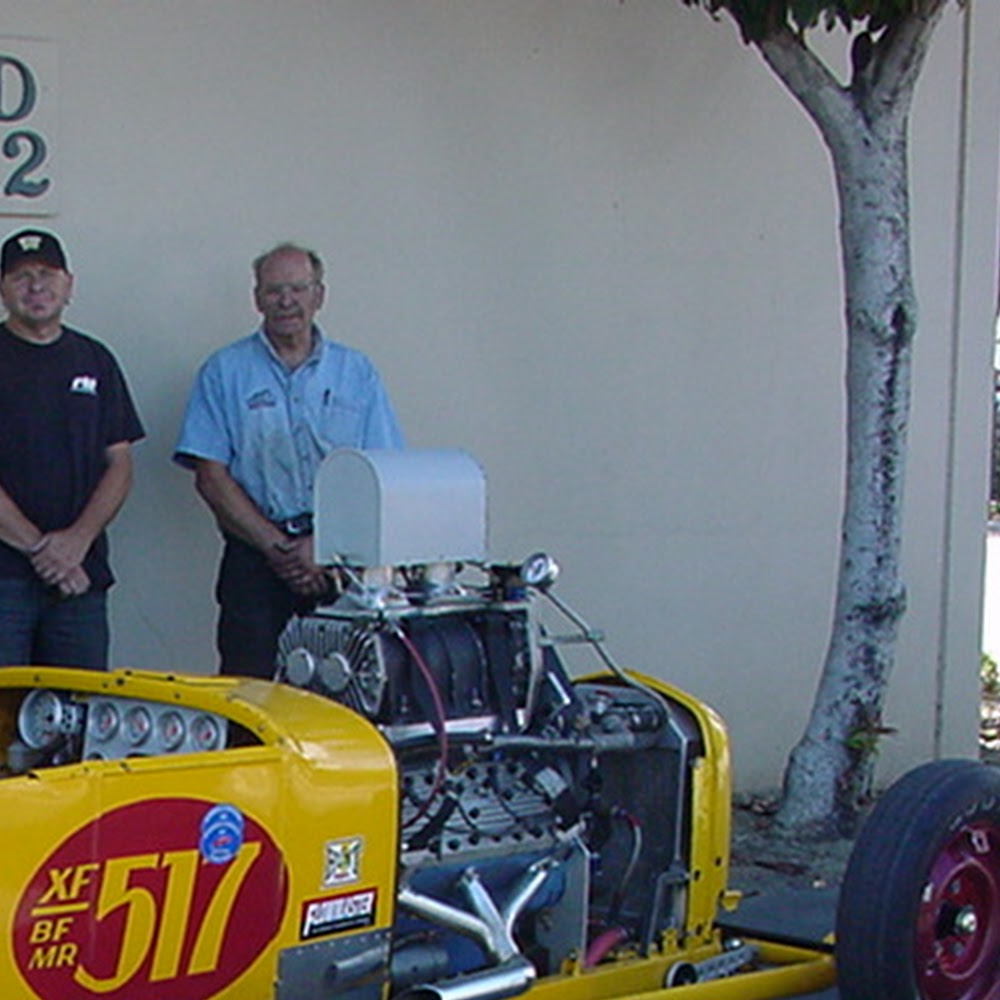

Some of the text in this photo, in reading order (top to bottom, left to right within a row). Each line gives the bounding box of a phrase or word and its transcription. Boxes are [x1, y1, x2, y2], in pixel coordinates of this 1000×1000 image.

[38, 863, 101, 905] XF
[29, 917, 76, 945] BF
[73, 842, 262, 994] 517
[28, 943, 78, 970] MR
